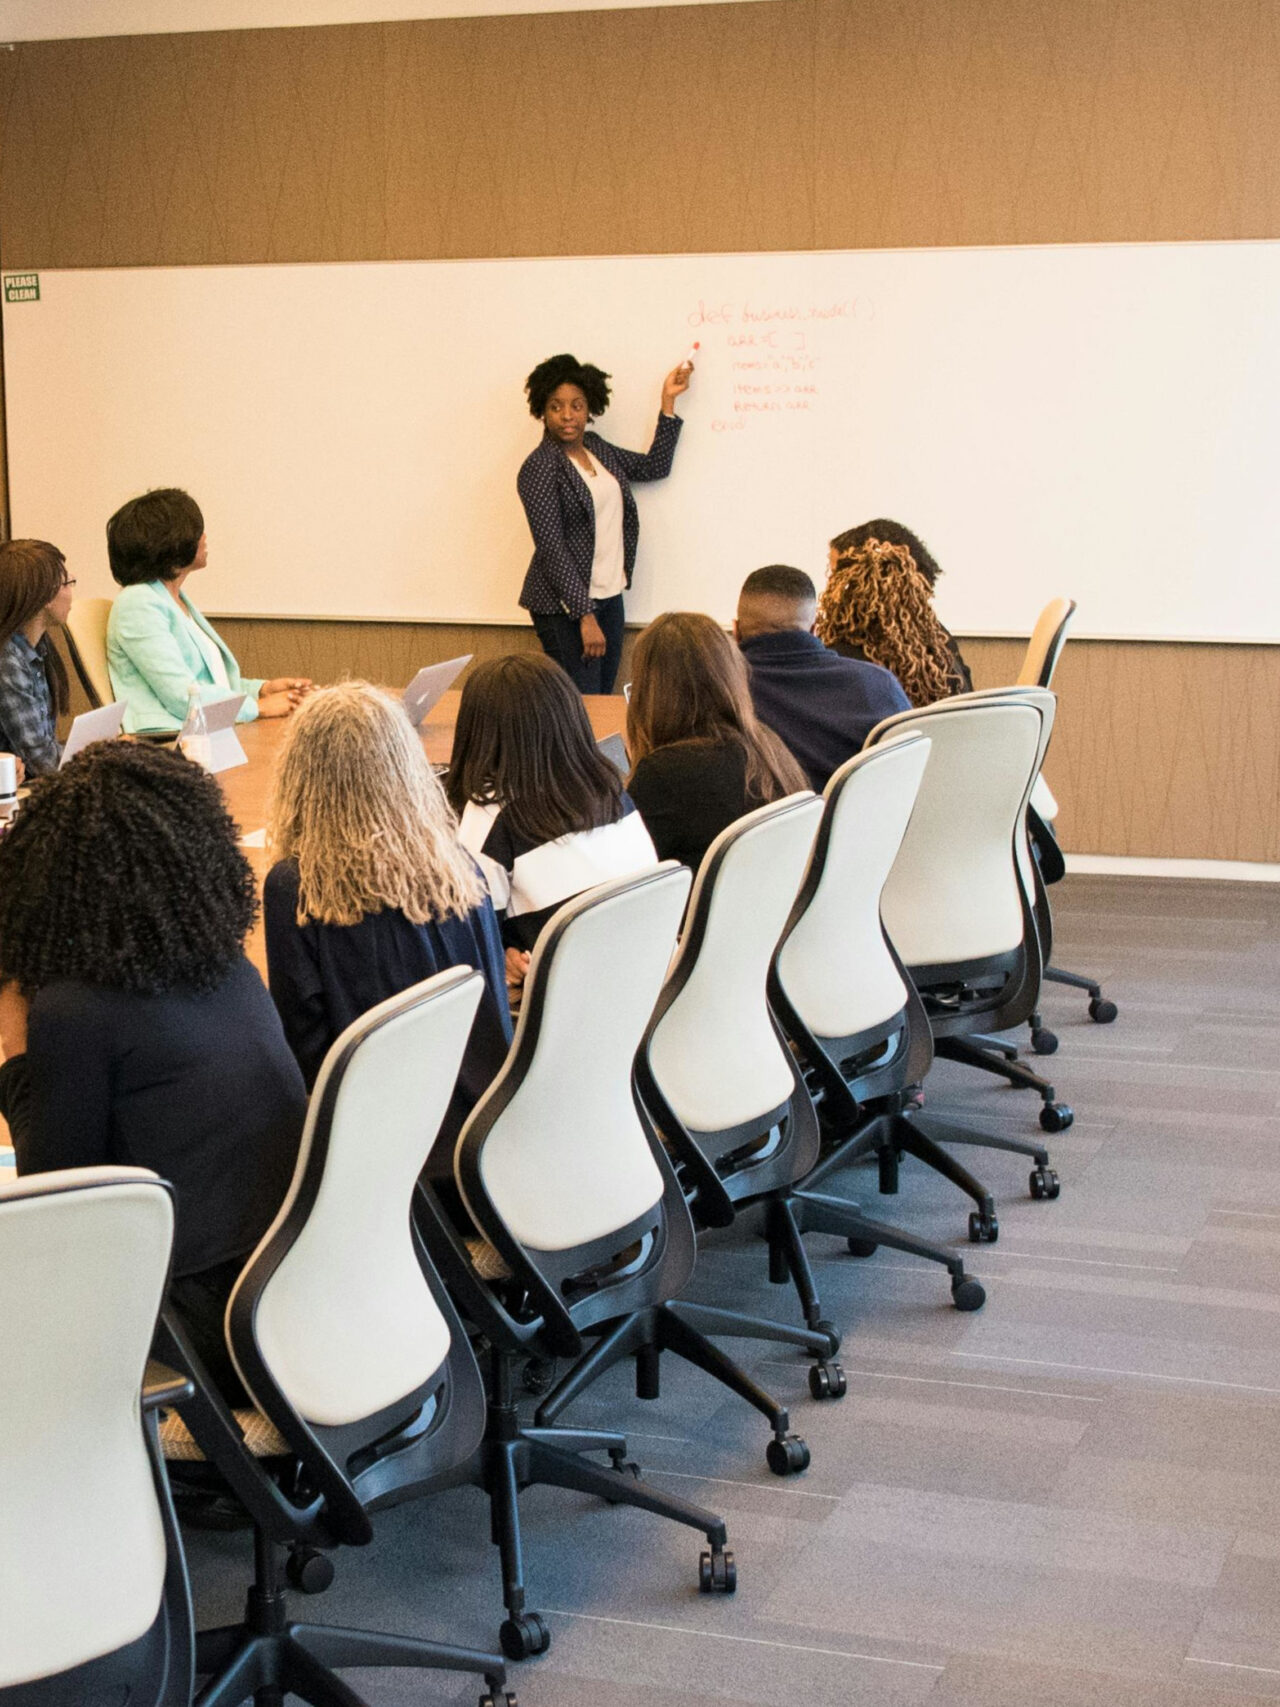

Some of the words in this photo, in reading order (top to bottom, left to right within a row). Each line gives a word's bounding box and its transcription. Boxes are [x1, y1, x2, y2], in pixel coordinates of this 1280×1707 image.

[6, 276, 37, 288] PLEASE
[9, 289, 36, 300] CLEAN
[687, 299, 734, 327] def
